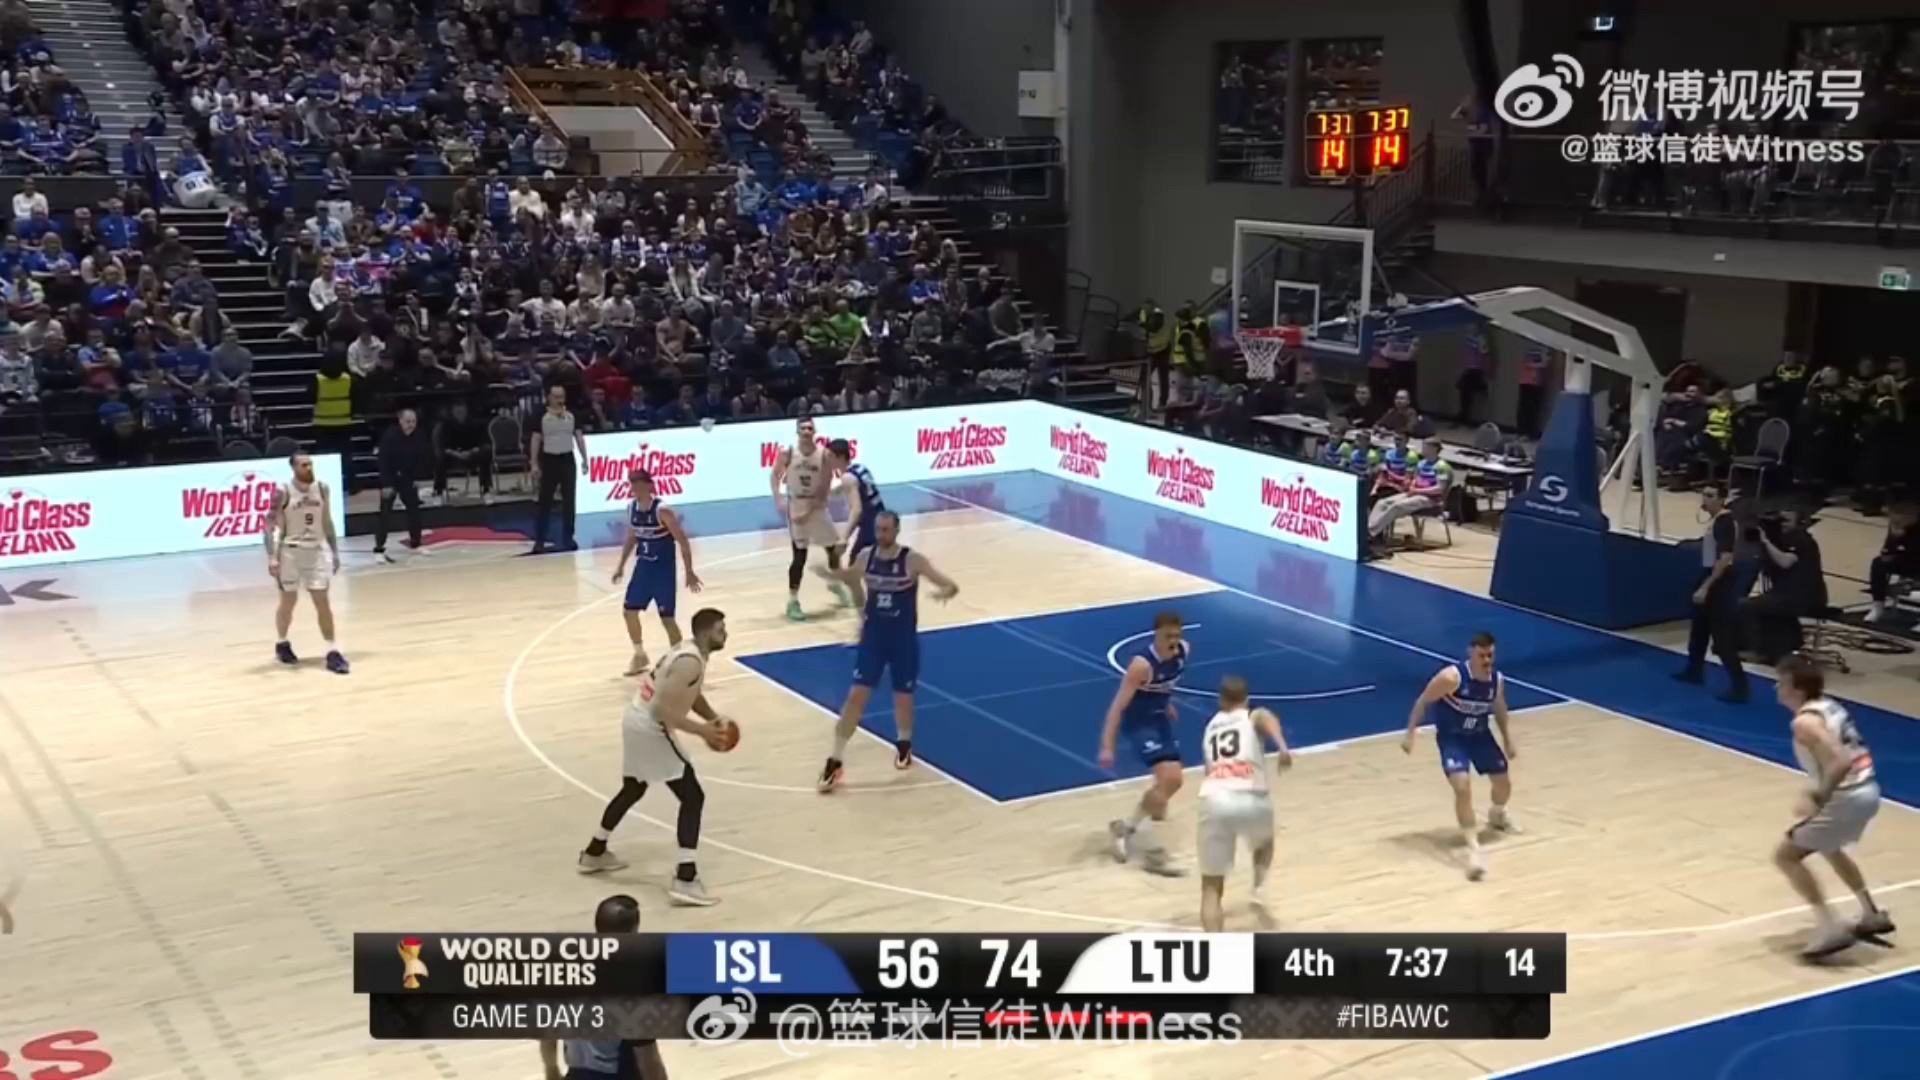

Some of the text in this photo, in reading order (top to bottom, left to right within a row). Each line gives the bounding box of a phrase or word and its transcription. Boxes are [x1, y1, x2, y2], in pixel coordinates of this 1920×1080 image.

[1322, 139, 1345, 168] 14
[1373, 134, 1400, 166] 14
[917, 423, 1007, 453] World Class
[1050, 425, 1108, 462] World Class
[648, 451, 696, 477] Class
[930, 449, 996, 470] ICELAND
[1147, 449, 1215, 490] World Class
[182, 483, 251, 519] World
[1156, 479, 1206, 508] ICELAND
[1261, 477, 1341, 523] World Class
[23, 499, 91, 531] Class
[305, 512, 314, 526] 9
[1271, 510, 1329, 542] ICELAND
[1209, 729, 1240, 762] 13
